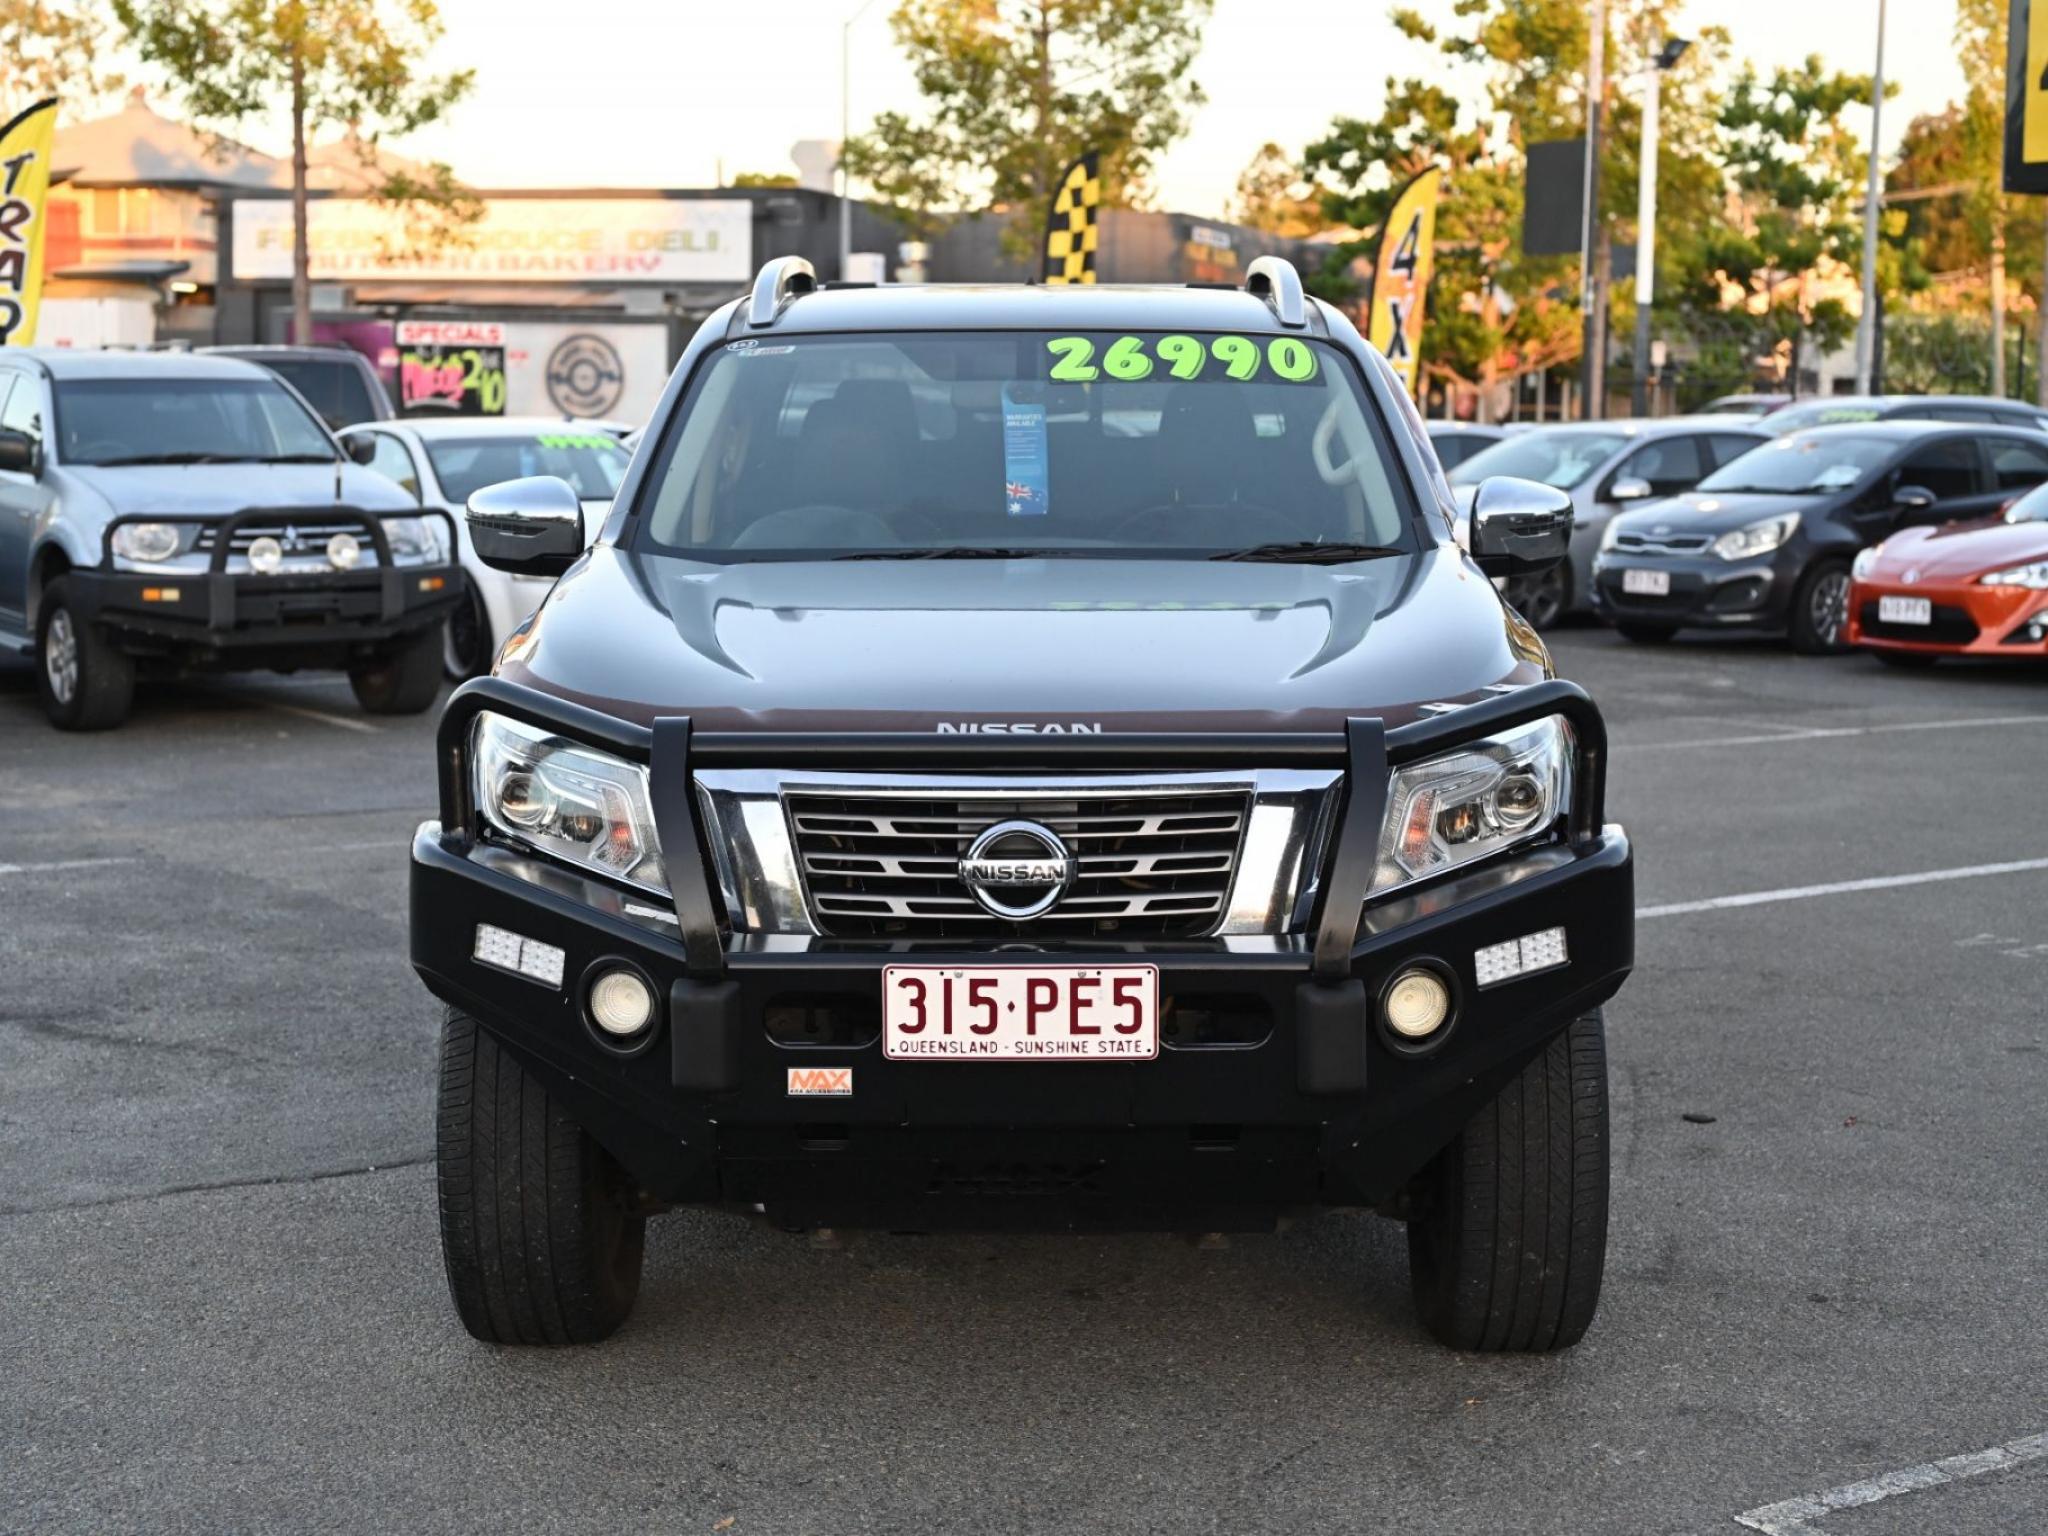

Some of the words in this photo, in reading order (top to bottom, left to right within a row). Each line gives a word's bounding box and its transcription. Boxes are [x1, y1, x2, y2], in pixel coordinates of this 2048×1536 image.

[626, 229, 717, 251] DELI
[403, 326, 499, 343] SPECIALS
[1047, 335, 1318, 381] 26990
[970, 865, 1065, 880] NISSAN
[900, 1040, 998, 1054] QUEENSLAND
[1015, 1040, 1089, 1054] SUNSHINE
[1098, 1040, 1142, 1053] STATE
[790, 1070, 850, 1088] MAX
